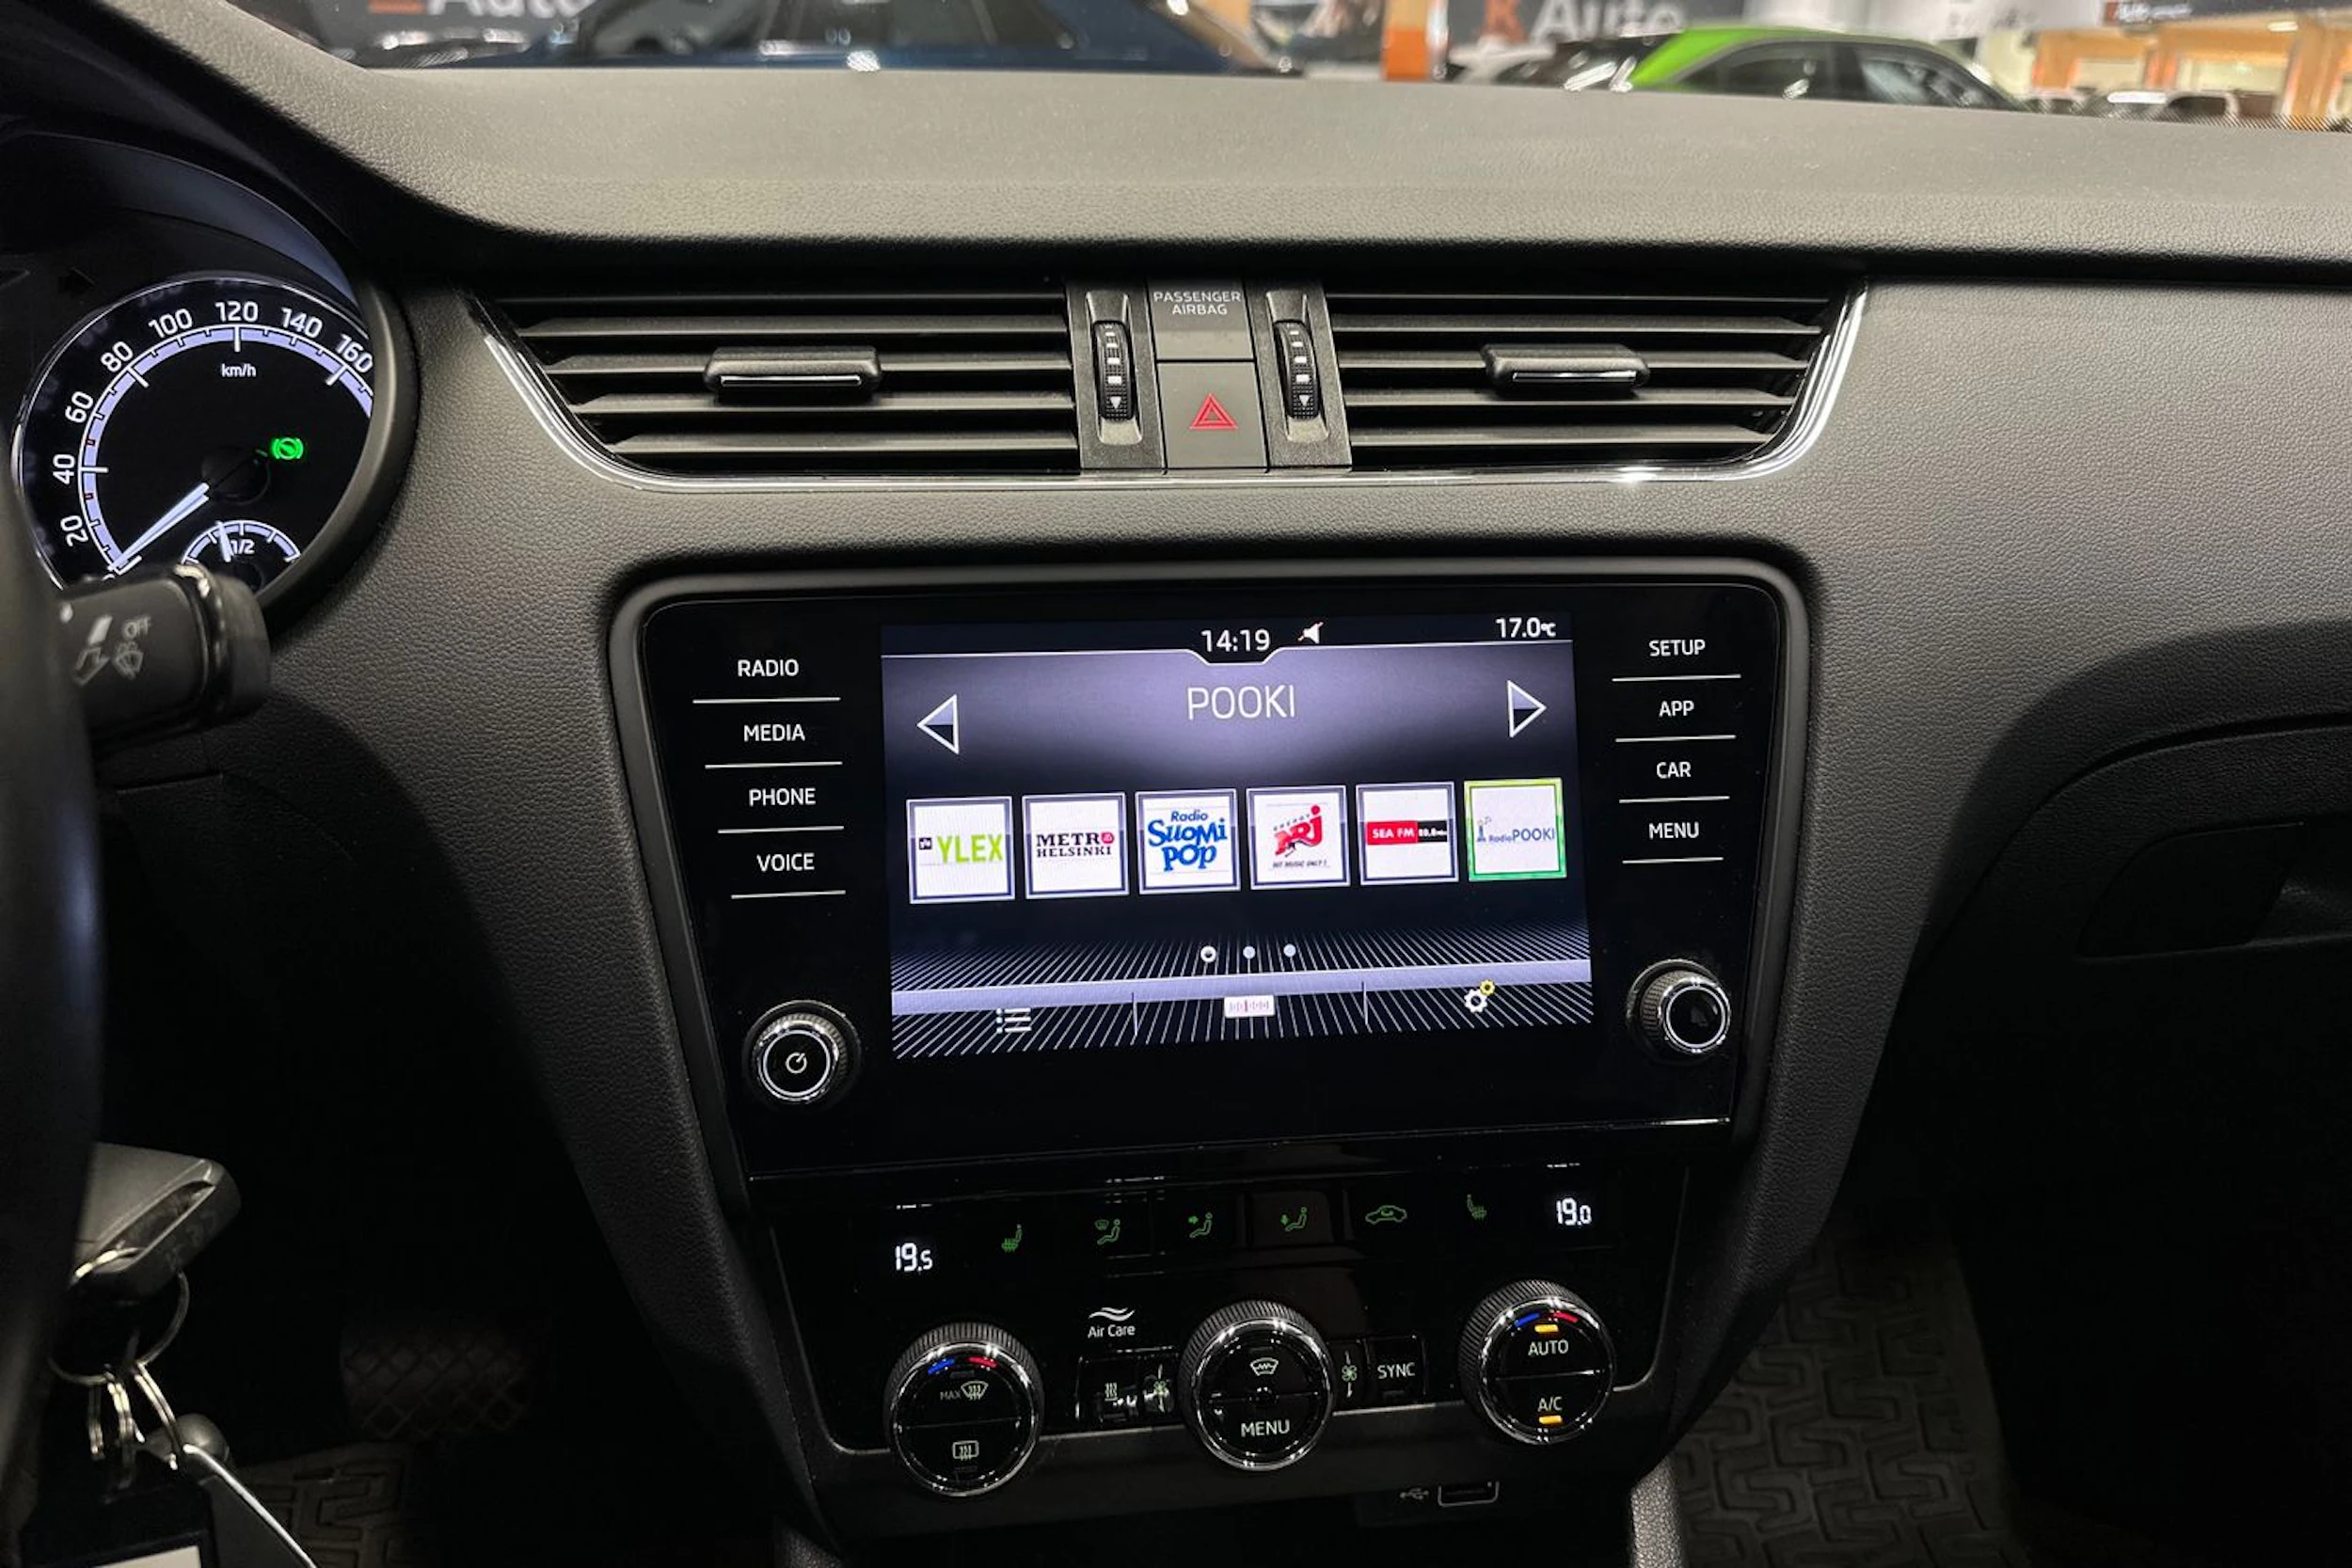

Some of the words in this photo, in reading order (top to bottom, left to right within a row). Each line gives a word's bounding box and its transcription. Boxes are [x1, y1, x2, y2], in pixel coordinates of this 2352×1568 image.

[1153, 292, 1241, 303] PASSENGER
[215, 302, 259, 323] 120
[1172, 304, 1228, 315] AIRBAG
[148, 308, 194, 340] 100
[281, 307, 324, 339] 140
[100, 341, 134, 372] 80
[335, 334, 373, 374] 160
[221, 363, 257, 378] km/h
[64, 391, 94, 424] 60
[53, 453, 76, 483] 40
[60, 515, 89, 546] 20
[1200, 628, 1270, 653] 14:19
[1648, 639, 1706, 657] SETUP
[737, 658, 800, 677] RADIO
[1187, 684, 1295, 721] POOKI
[1658, 700, 1694, 718] APP
[743, 723, 806, 742] MEDIA
[1656, 761, 1692, 779] CAR
[748, 787, 817, 806] PHONE
[1170, 809, 1208, 822] Radio
[1372, 828, 1394, 839] SEA
[1396, 827, 1415, 839] FM
[1648, 821, 1700, 840] MENU
[937, 833, 1003, 863] YLEX
[1037, 846, 1112, 858] HELSINKI
[756, 852, 815, 872] VOICE
[1555, 1196, 1592, 1226] 19.0
[895, 1242, 933, 1273] 19.5
[1087, 1325, 1104, 1338] Air
[1107, 1323, 1136, 1337] Care
[1528, 1339, 1569, 1356] AUTO
[1376, 1362, 1416, 1379] SYNC
[940, 1390, 961, 1401] MAX
[1537, 1396, 1563, 1413] A/C
[1240, 1419, 1290, 1437] MENU
